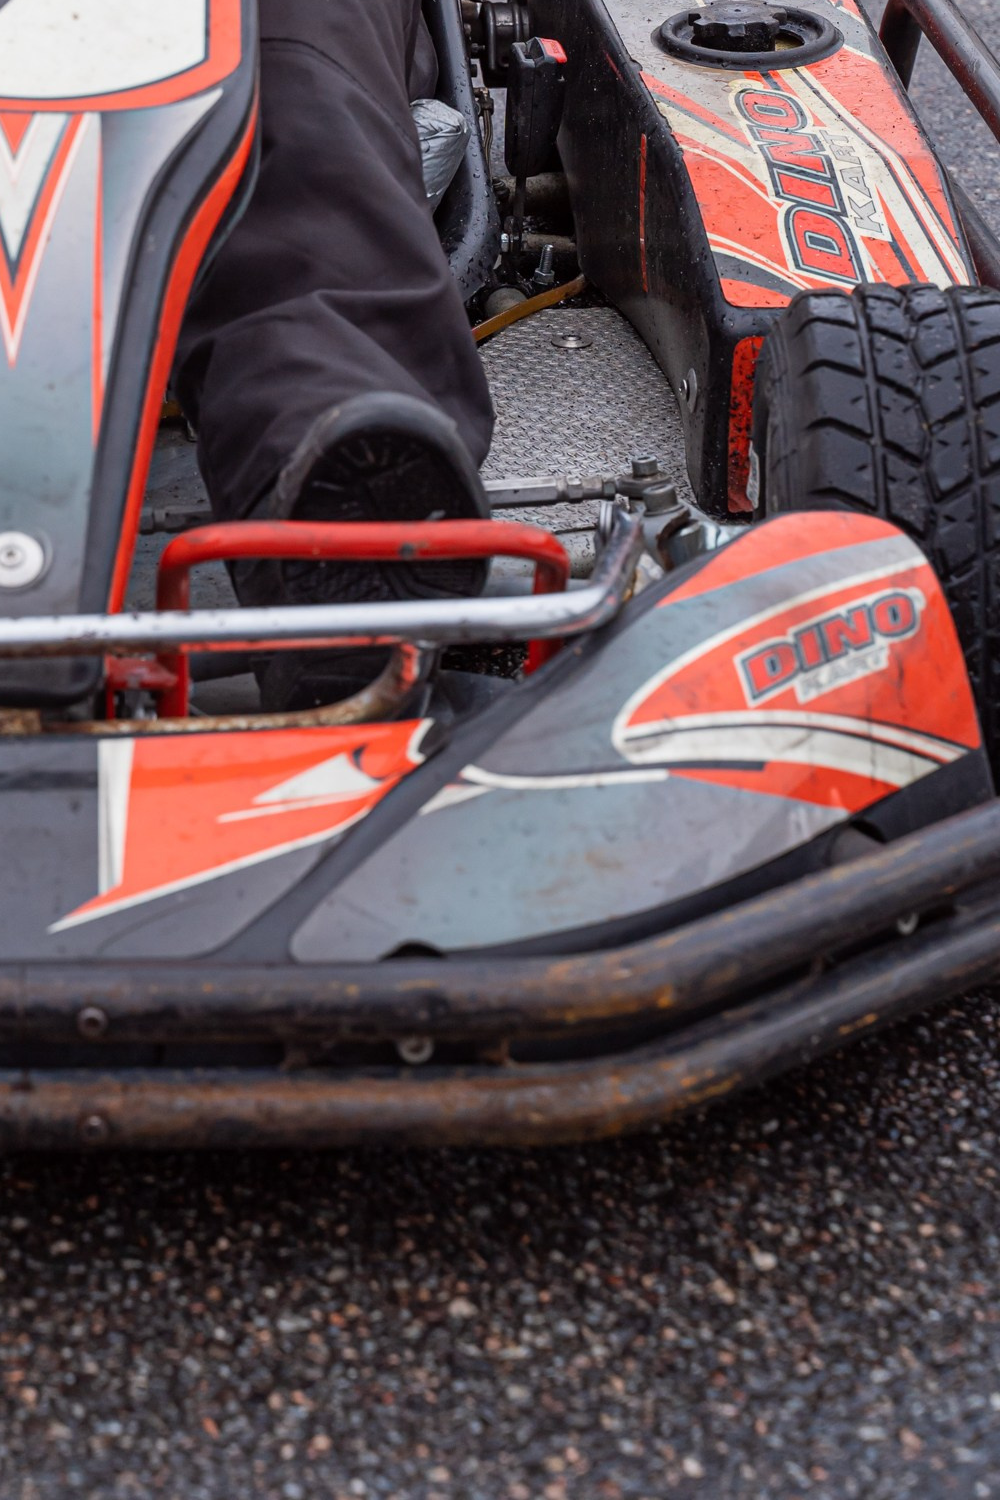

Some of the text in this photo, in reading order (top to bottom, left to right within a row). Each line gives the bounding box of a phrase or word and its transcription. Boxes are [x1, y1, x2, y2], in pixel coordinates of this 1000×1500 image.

[734, 87, 870, 285] DINO
[819, 129, 883, 234] KART
[741, 591, 918, 700] DINO
